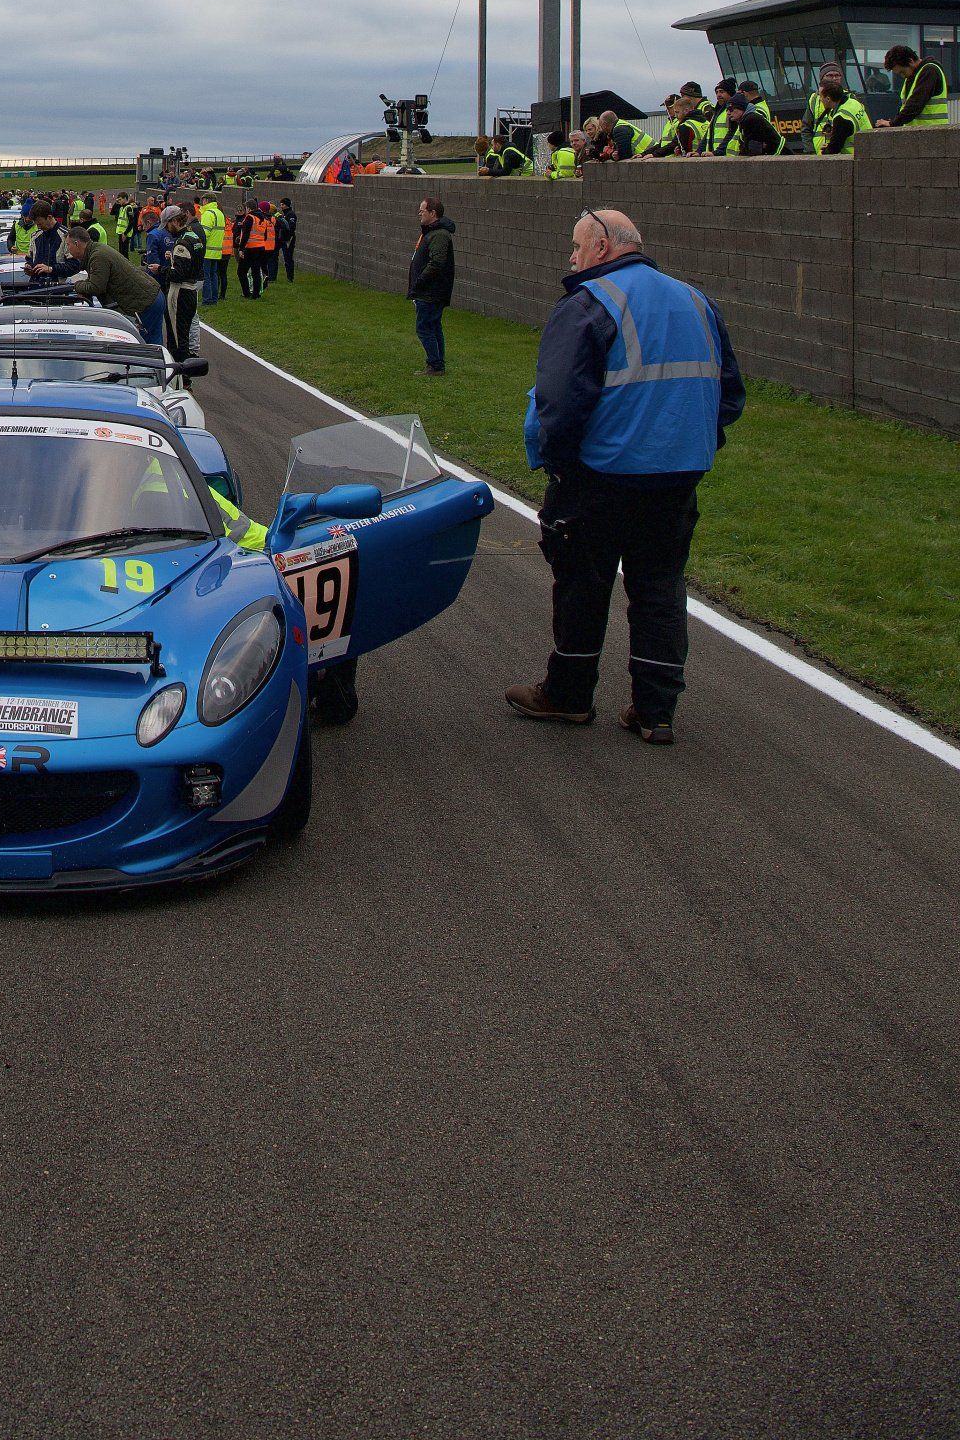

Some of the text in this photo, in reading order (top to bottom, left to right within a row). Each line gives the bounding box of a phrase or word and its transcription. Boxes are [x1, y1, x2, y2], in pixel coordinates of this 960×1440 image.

[148, 434, 163, 448] D
[345, 504, 417, 532] PETER MANSFIELD
[100, 557, 155, 594] 19
[26, 699, 60, 707] NOVEMBER
